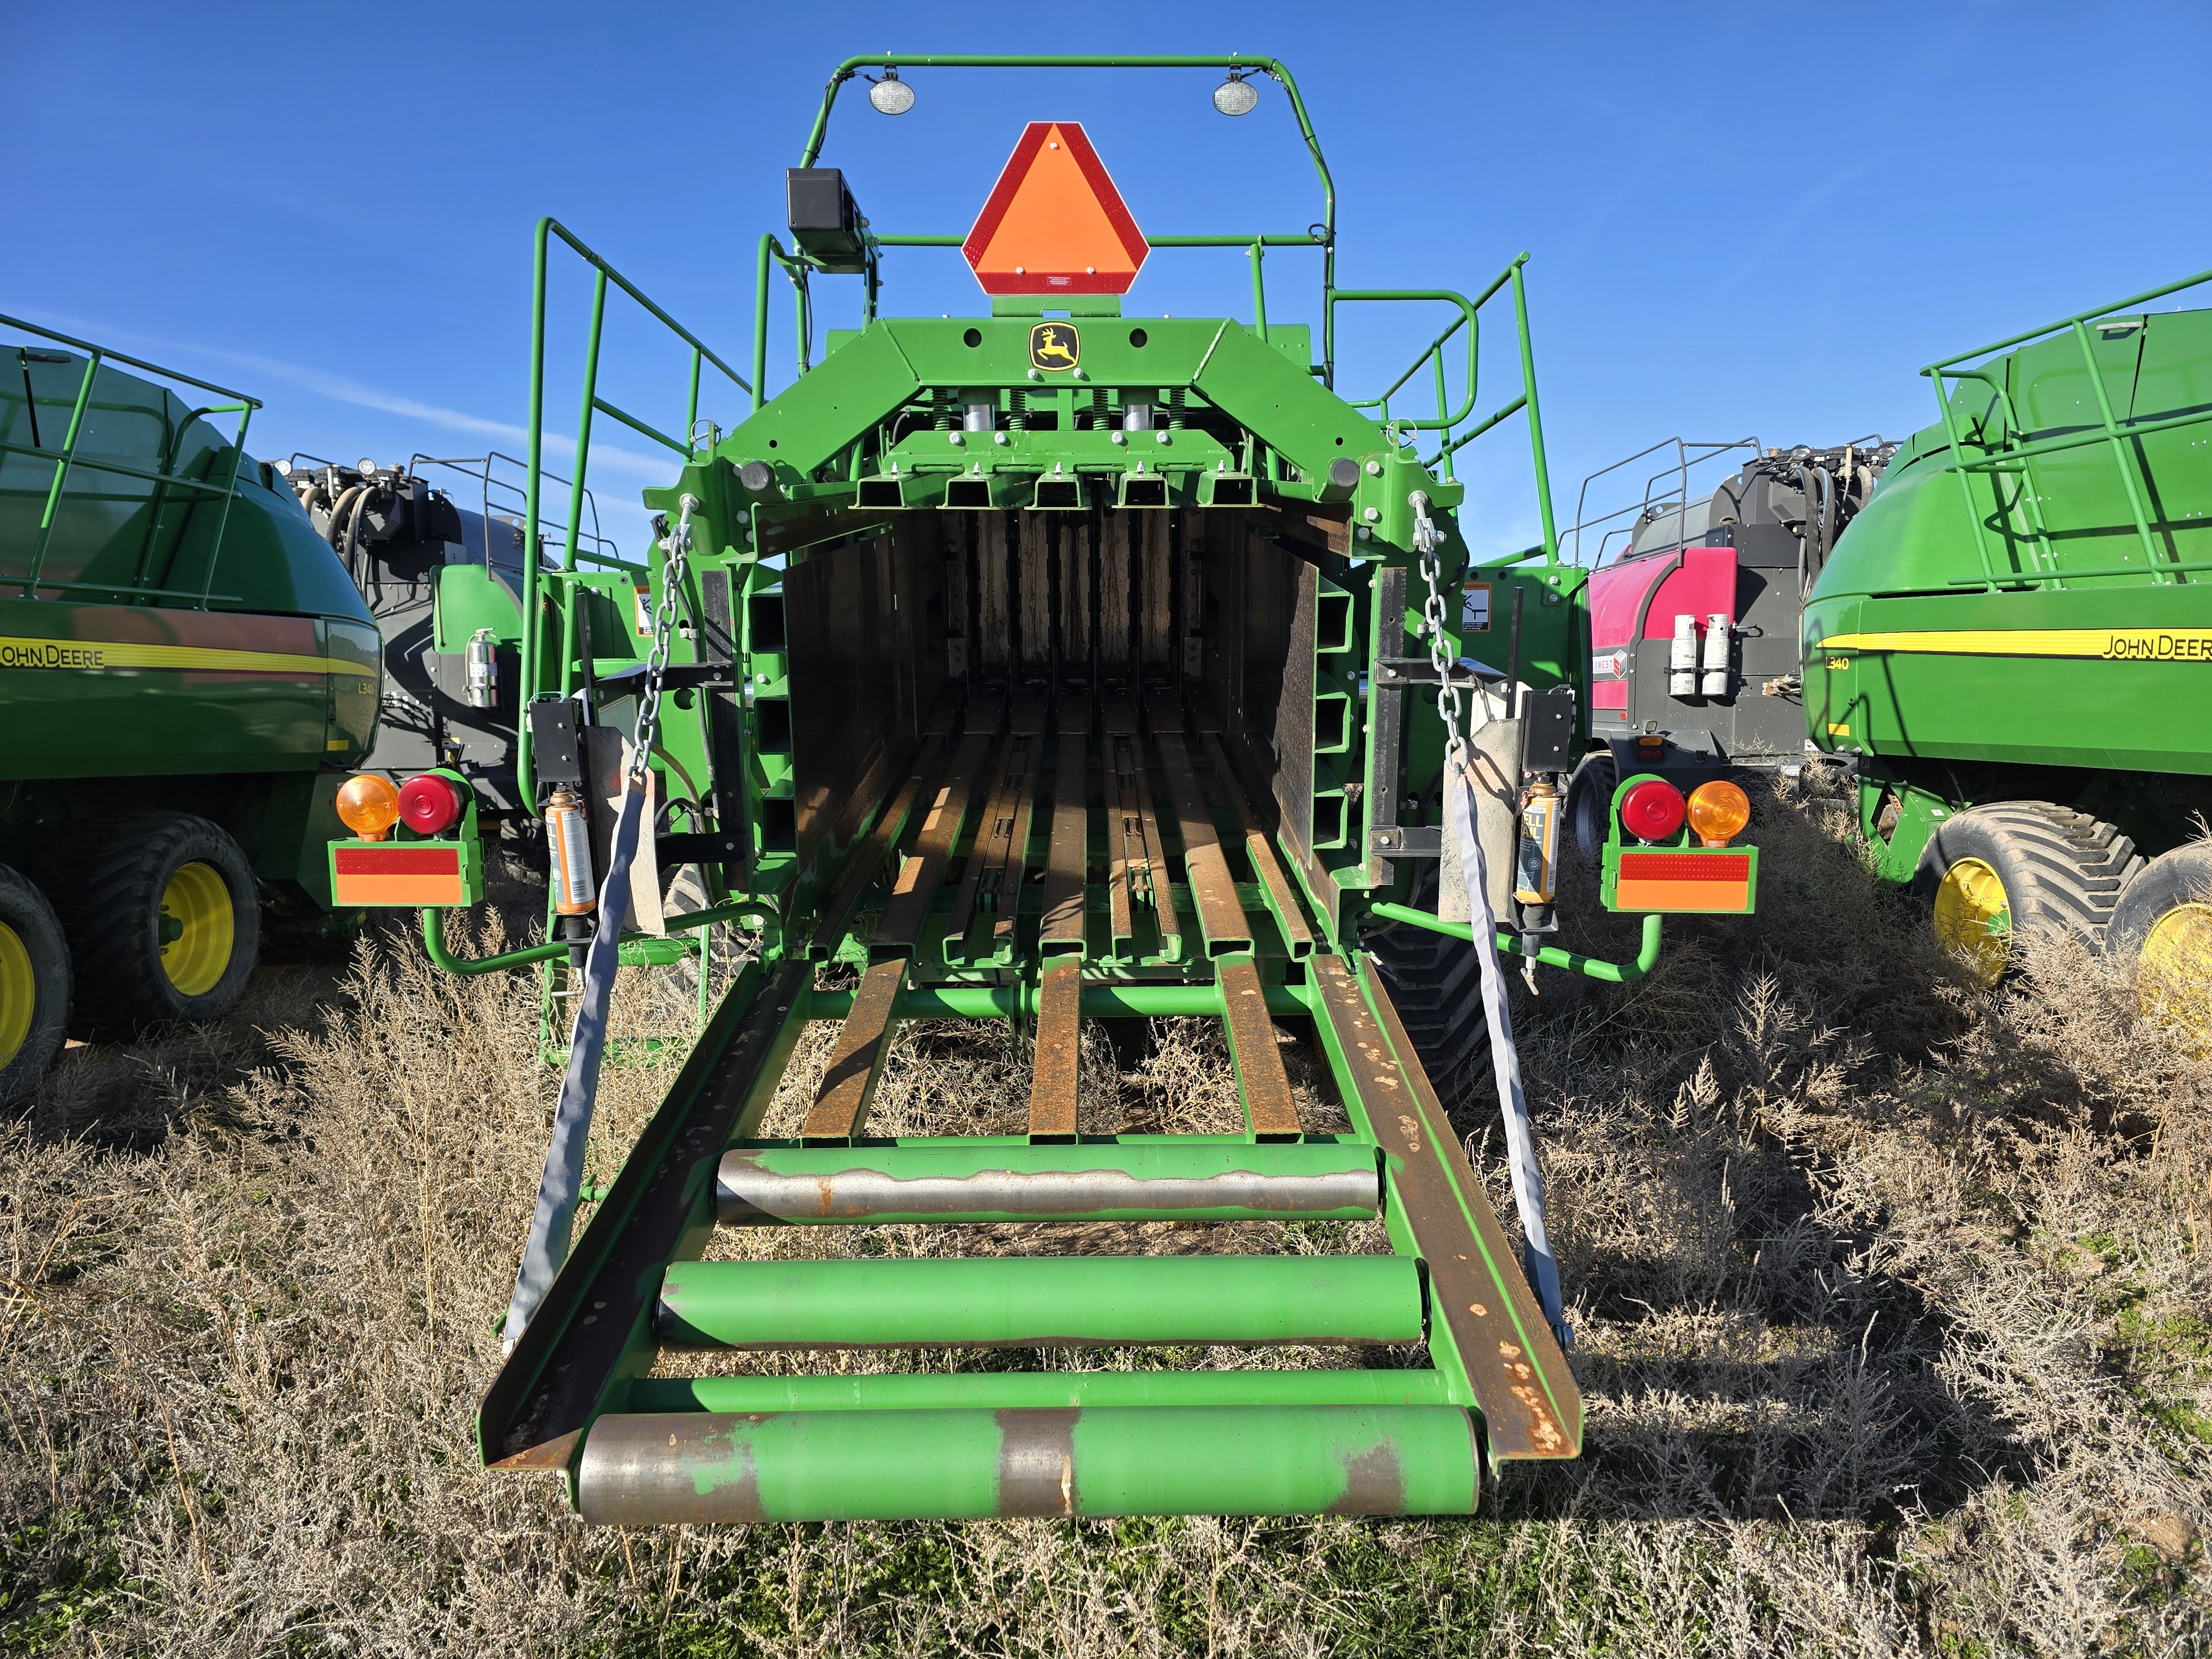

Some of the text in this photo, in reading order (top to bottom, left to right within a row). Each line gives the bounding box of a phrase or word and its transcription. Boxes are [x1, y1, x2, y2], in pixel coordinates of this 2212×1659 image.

[2104, 635, 2212, 656] JOHN DEER
[2, 644, 105, 666] OHN DEERE
[1825, 656, 1850, 670] L340
[1594, 660, 1613, 669] IWEST
